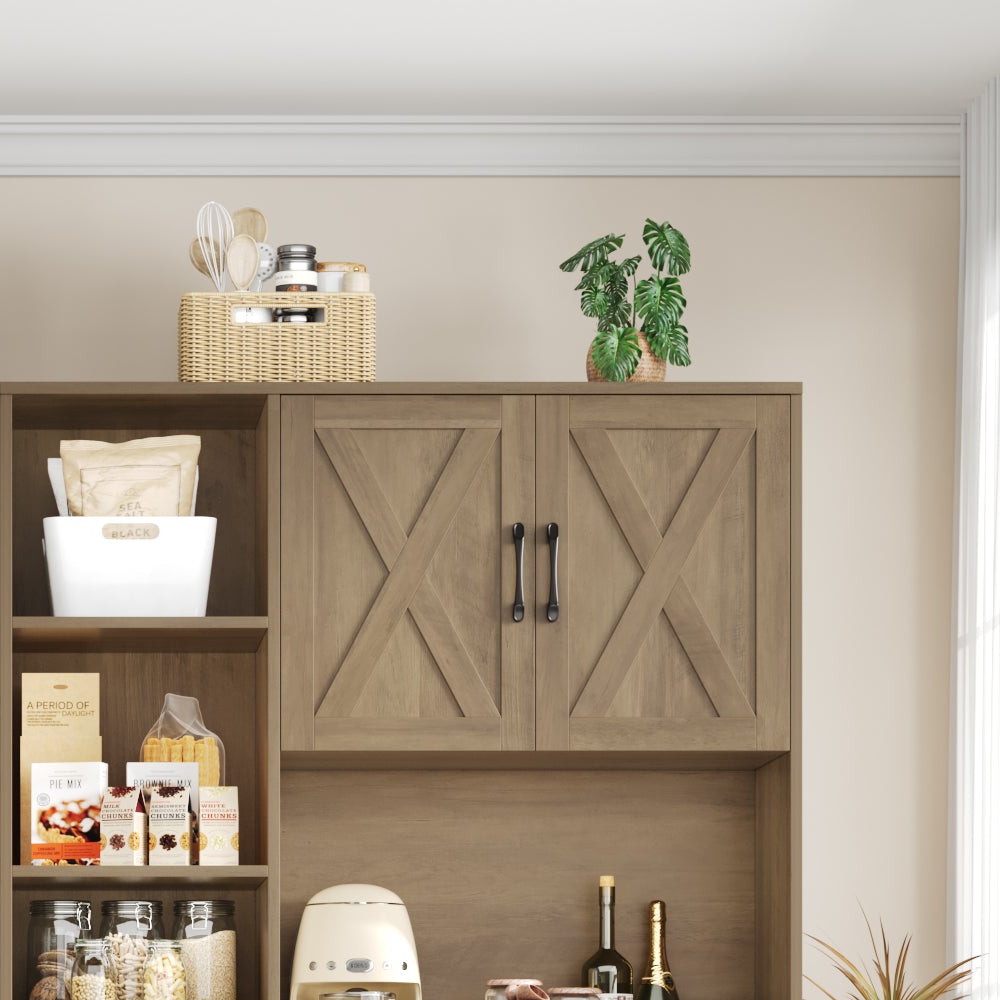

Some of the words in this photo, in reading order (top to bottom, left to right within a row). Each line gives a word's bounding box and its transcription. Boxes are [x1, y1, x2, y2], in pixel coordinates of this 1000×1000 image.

[119, 502, 142, 511] SEA
[111, 527, 151, 538] BLACK
[27, 701, 34, 710] A
[36, 701, 74, 710] PERIOD
[76, 701, 90, 710] OF
[49, 779, 63, 789] PIE
[66, 779, 82, 789] MIX
[134, 779, 172, 788] BROWNIE
[177, 779, 192, 788] MIX
